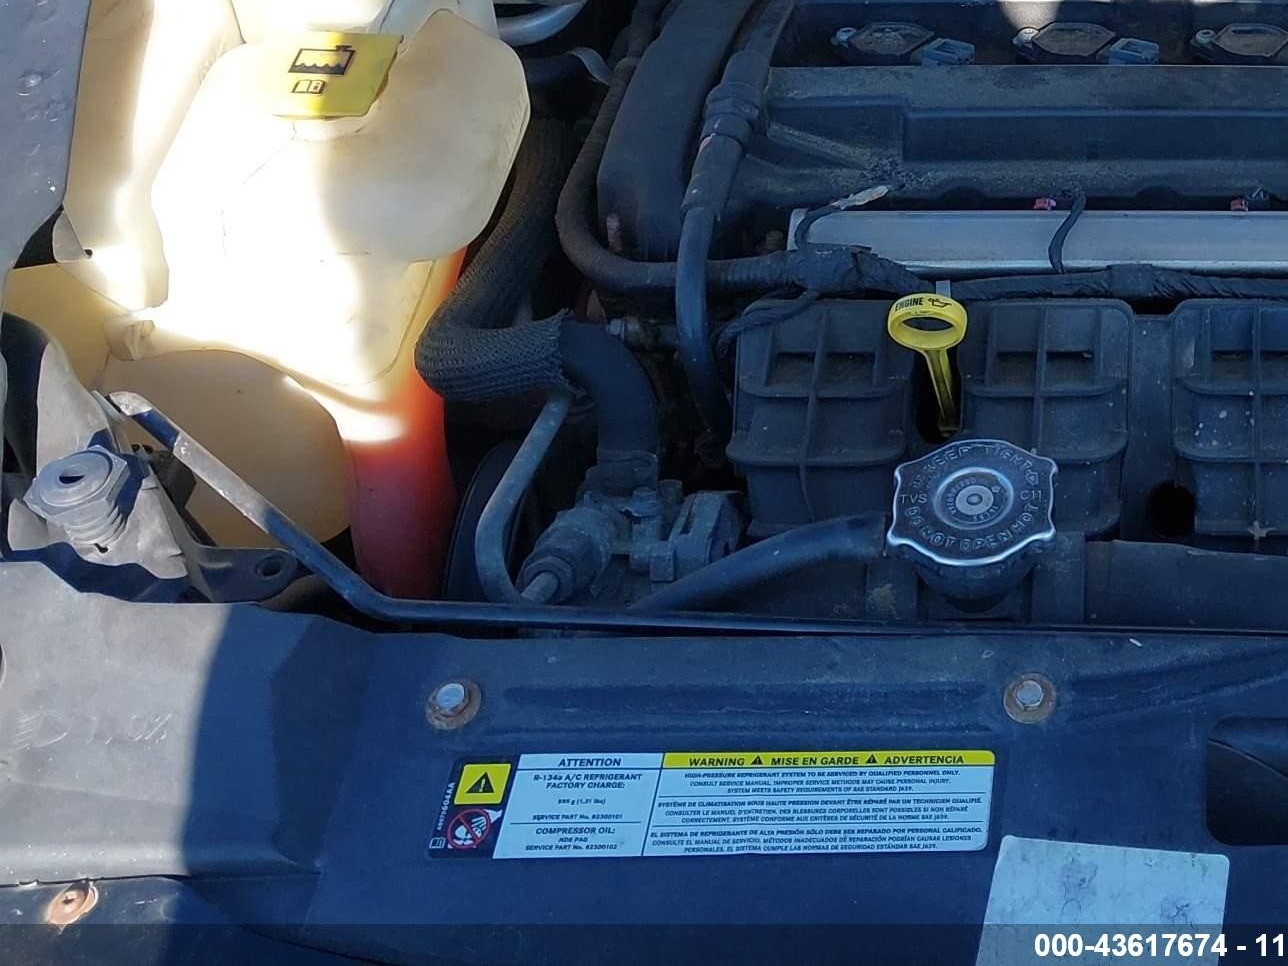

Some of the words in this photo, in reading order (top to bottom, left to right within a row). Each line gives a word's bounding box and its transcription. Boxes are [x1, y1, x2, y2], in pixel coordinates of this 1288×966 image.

[894, 297, 924, 312] ENGINE
[900, 493, 928, 504] TVS
[558, 758, 622, 767] ATTENTION
[689, 758, 745, 766] WARNING
[771, 757, 799, 766] MISE
[884, 756, 964, 764] ADVERTENCIA
